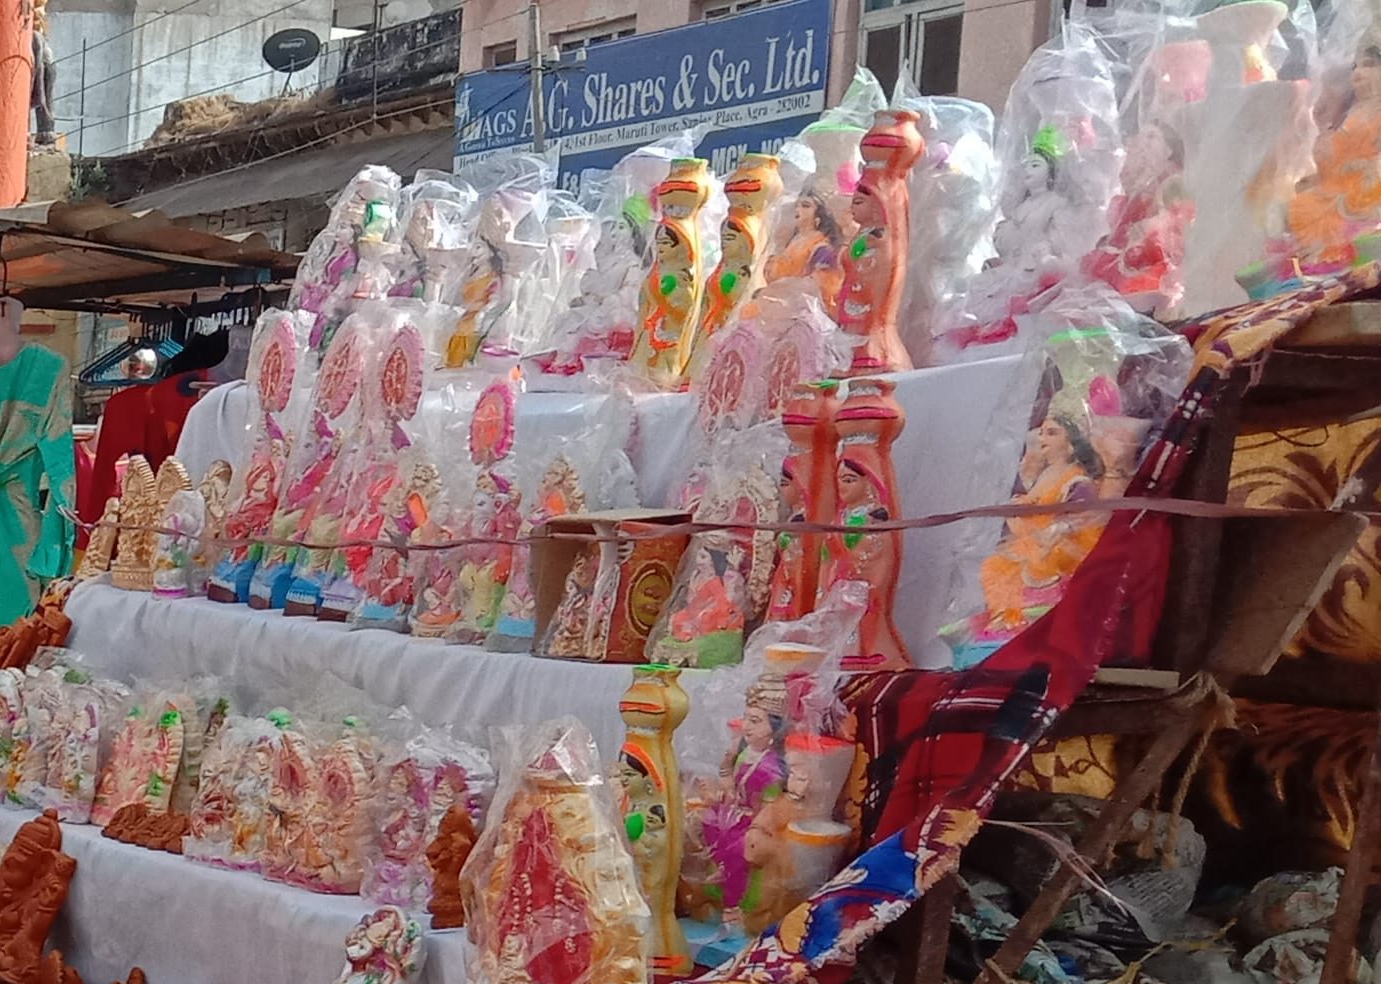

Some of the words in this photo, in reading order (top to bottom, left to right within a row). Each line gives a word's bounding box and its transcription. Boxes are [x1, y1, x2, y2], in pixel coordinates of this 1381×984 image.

[581, 71, 665, 128] Shares
[673, 54, 698, 111] &
[704, 48, 755, 106] Sec.
[763, 29, 820, 95] Ltd.
[617, 127, 648, 141] Maruti
[651, 121, 679, 134] Tower,
[747, 106, 768, 120] Agra
[776, 95, 811, 113] 282002
